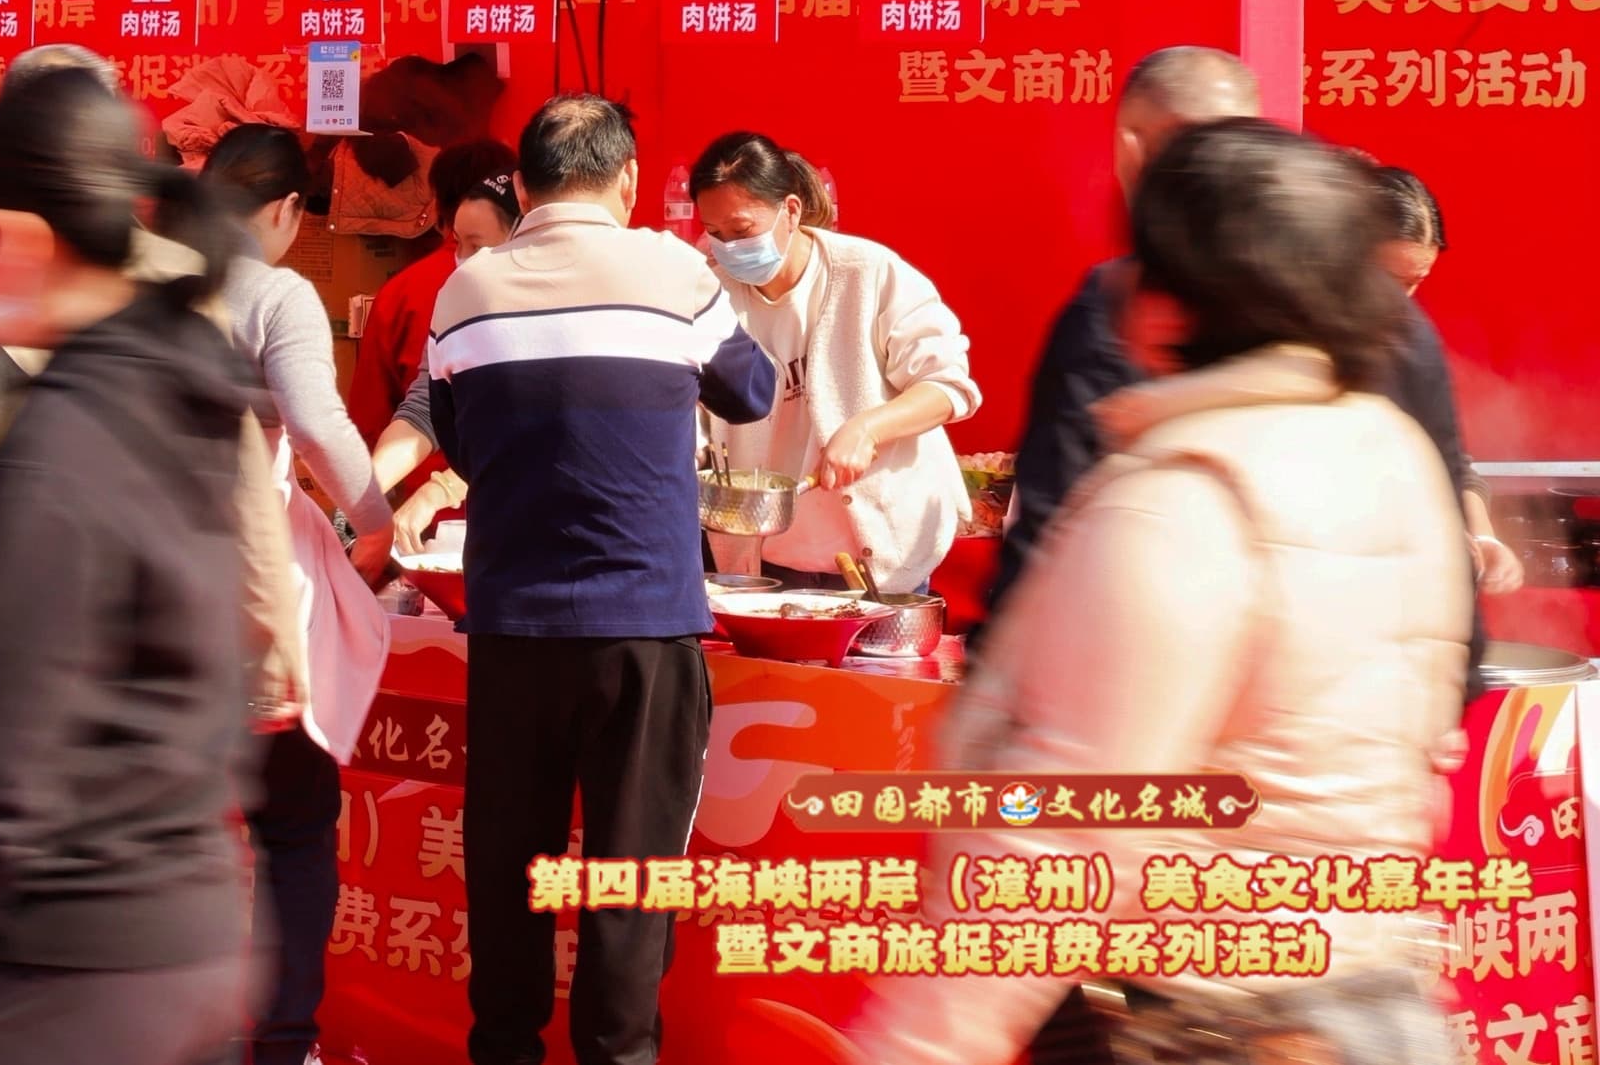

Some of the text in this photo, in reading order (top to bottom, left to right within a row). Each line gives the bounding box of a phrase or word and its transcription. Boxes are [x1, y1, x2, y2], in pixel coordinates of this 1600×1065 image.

[120, 10, 180, 37] 肉饼汤
[301, 8, 365, 36] 肉饼汤
[466, 5, 535, 34] 肉饼汤
[681, 2, 757, 32] 肉饼汤
[881, 0, 961, 31] 肉饼汤
[899, 48, 1112, 104] 暨文商旅
[1304, 48, 1587, 108] 系列活动
[1403, 890, 1578, 983] 峡两
